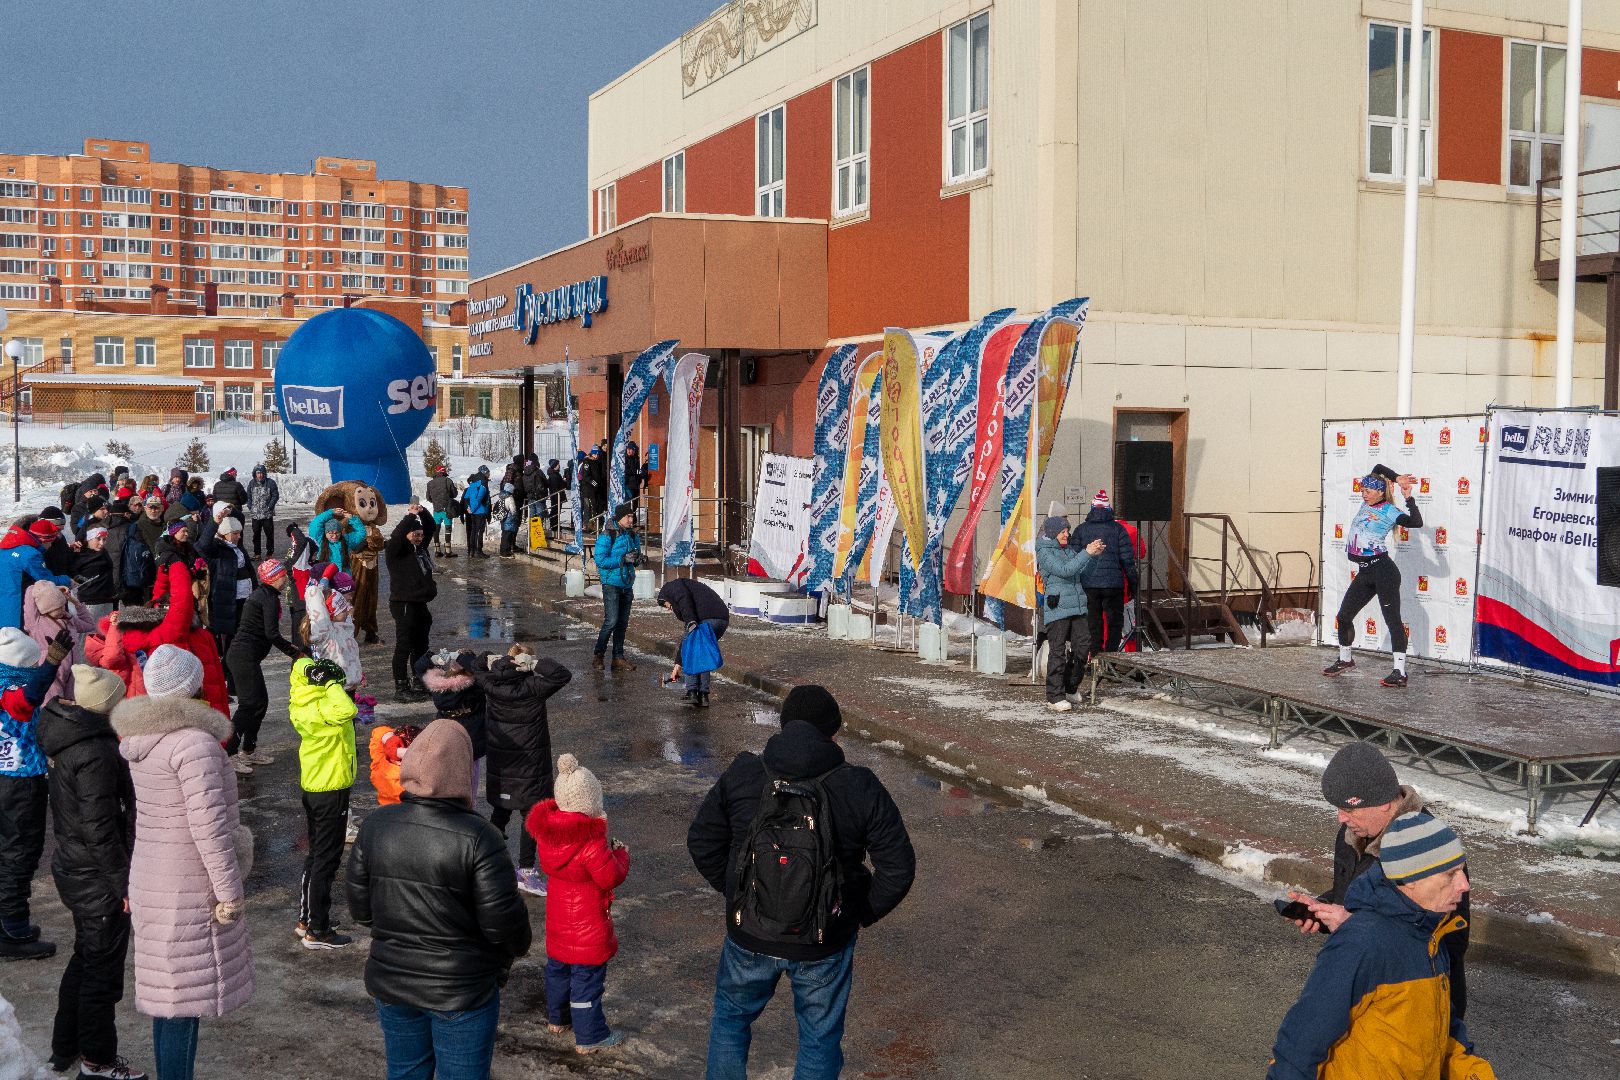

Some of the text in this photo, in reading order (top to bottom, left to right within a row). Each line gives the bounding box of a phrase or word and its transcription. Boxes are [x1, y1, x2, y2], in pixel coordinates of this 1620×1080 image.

[289, 397, 332, 415] bella
[1504, 425, 1591, 457] bella RUN
[1553, 488, 1597, 504] Зимни
[1532, 506, 1597, 526] Егорьевск
[1508, 526, 1558, 542] марафон
